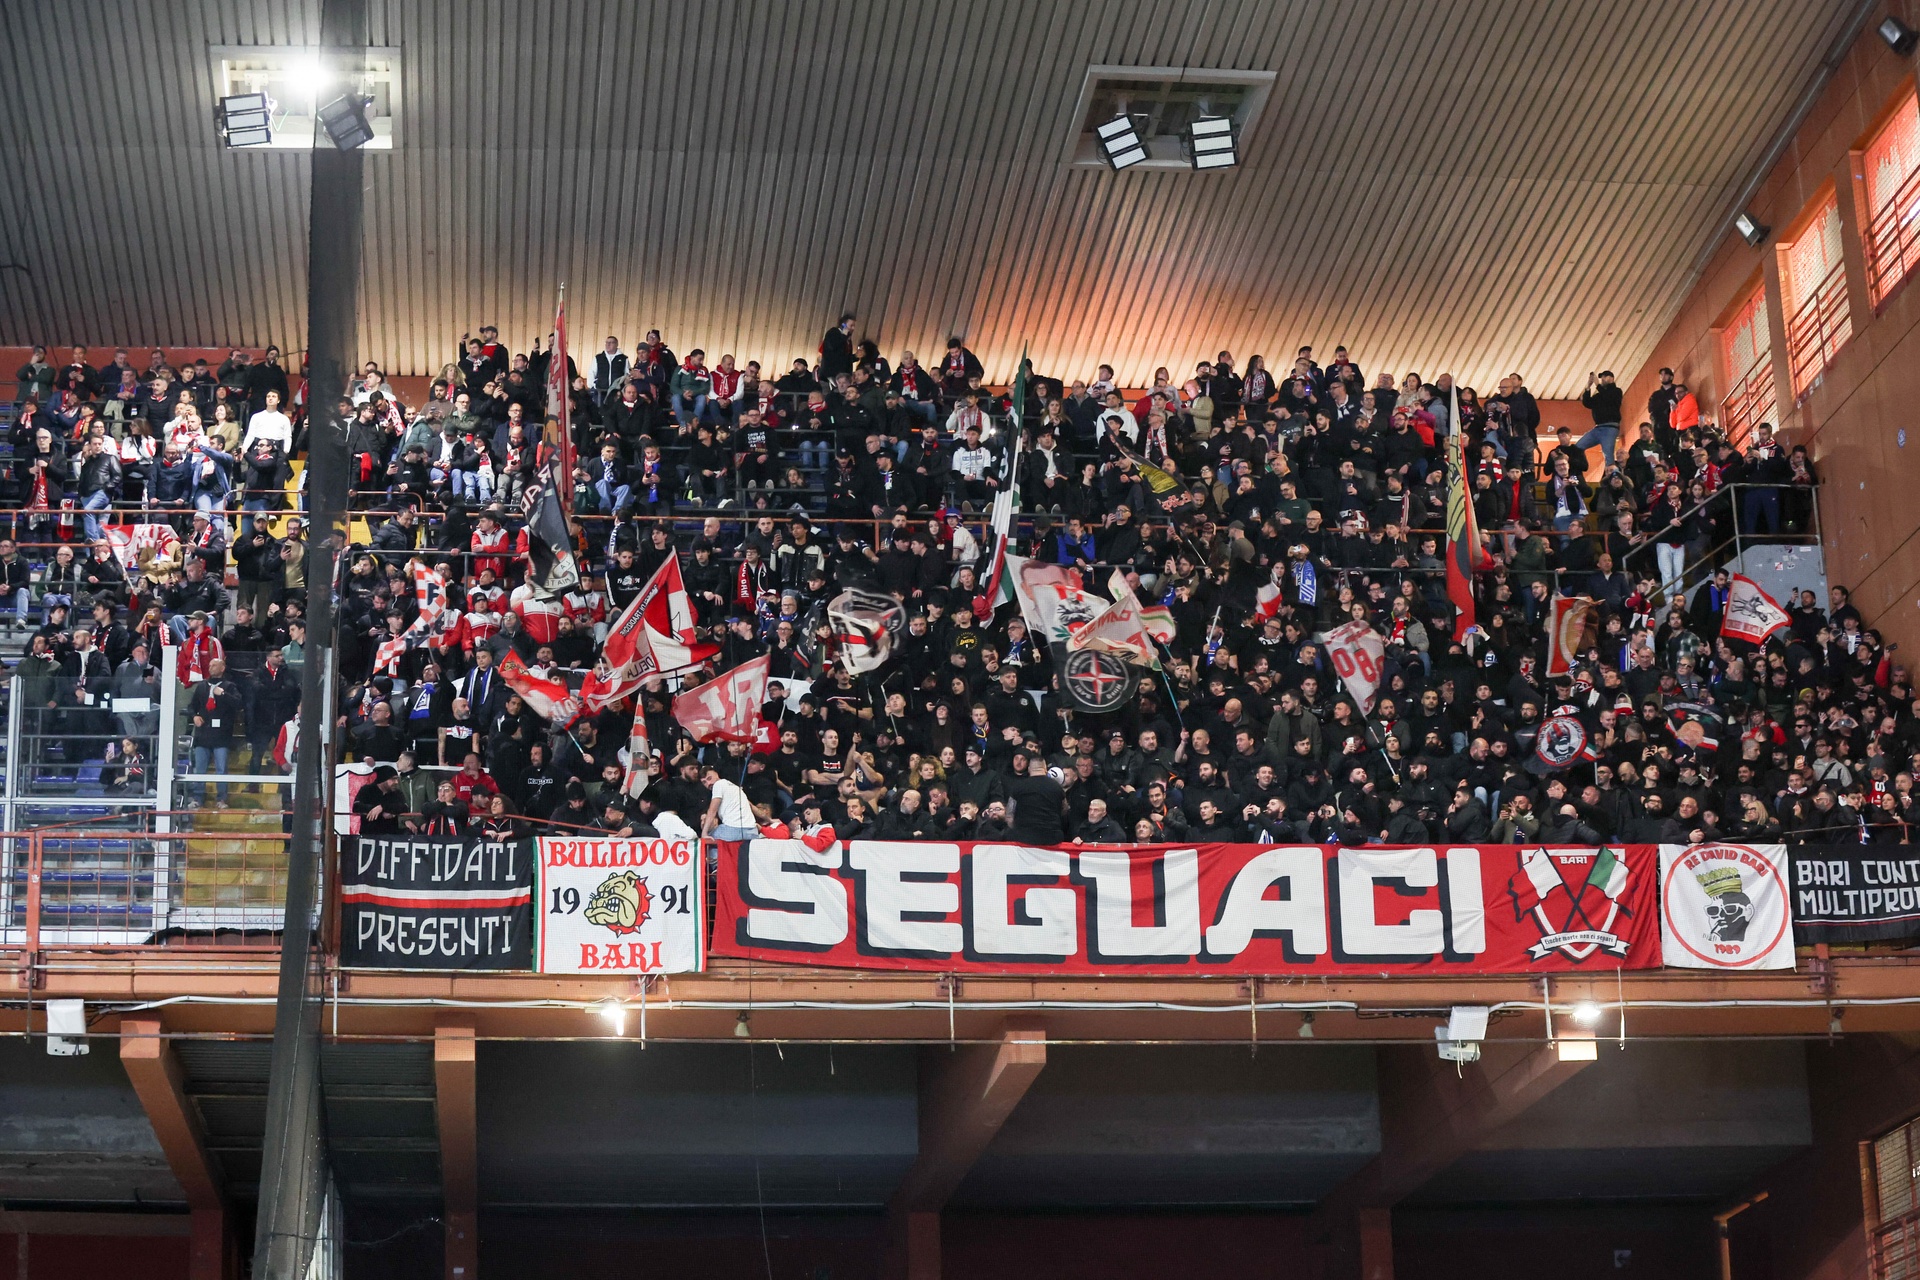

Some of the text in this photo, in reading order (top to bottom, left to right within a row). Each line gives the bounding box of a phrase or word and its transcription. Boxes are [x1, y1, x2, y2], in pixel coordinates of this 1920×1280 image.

[357, 838, 517, 882] DIFFIDATI
[547, 839, 690, 868] BULLDOG
[1560, 856, 1588, 865] BARI
[1684, 849, 1769, 877] RE DAVID BARI
[1796, 860, 1850, 885] BARI
[550, 886, 690, 914] 19 91
[740, 842, 1486, 958] SEGUACI
[358, 911, 511, 956] PRESENTI
[578, 942, 663, 970] BARI
